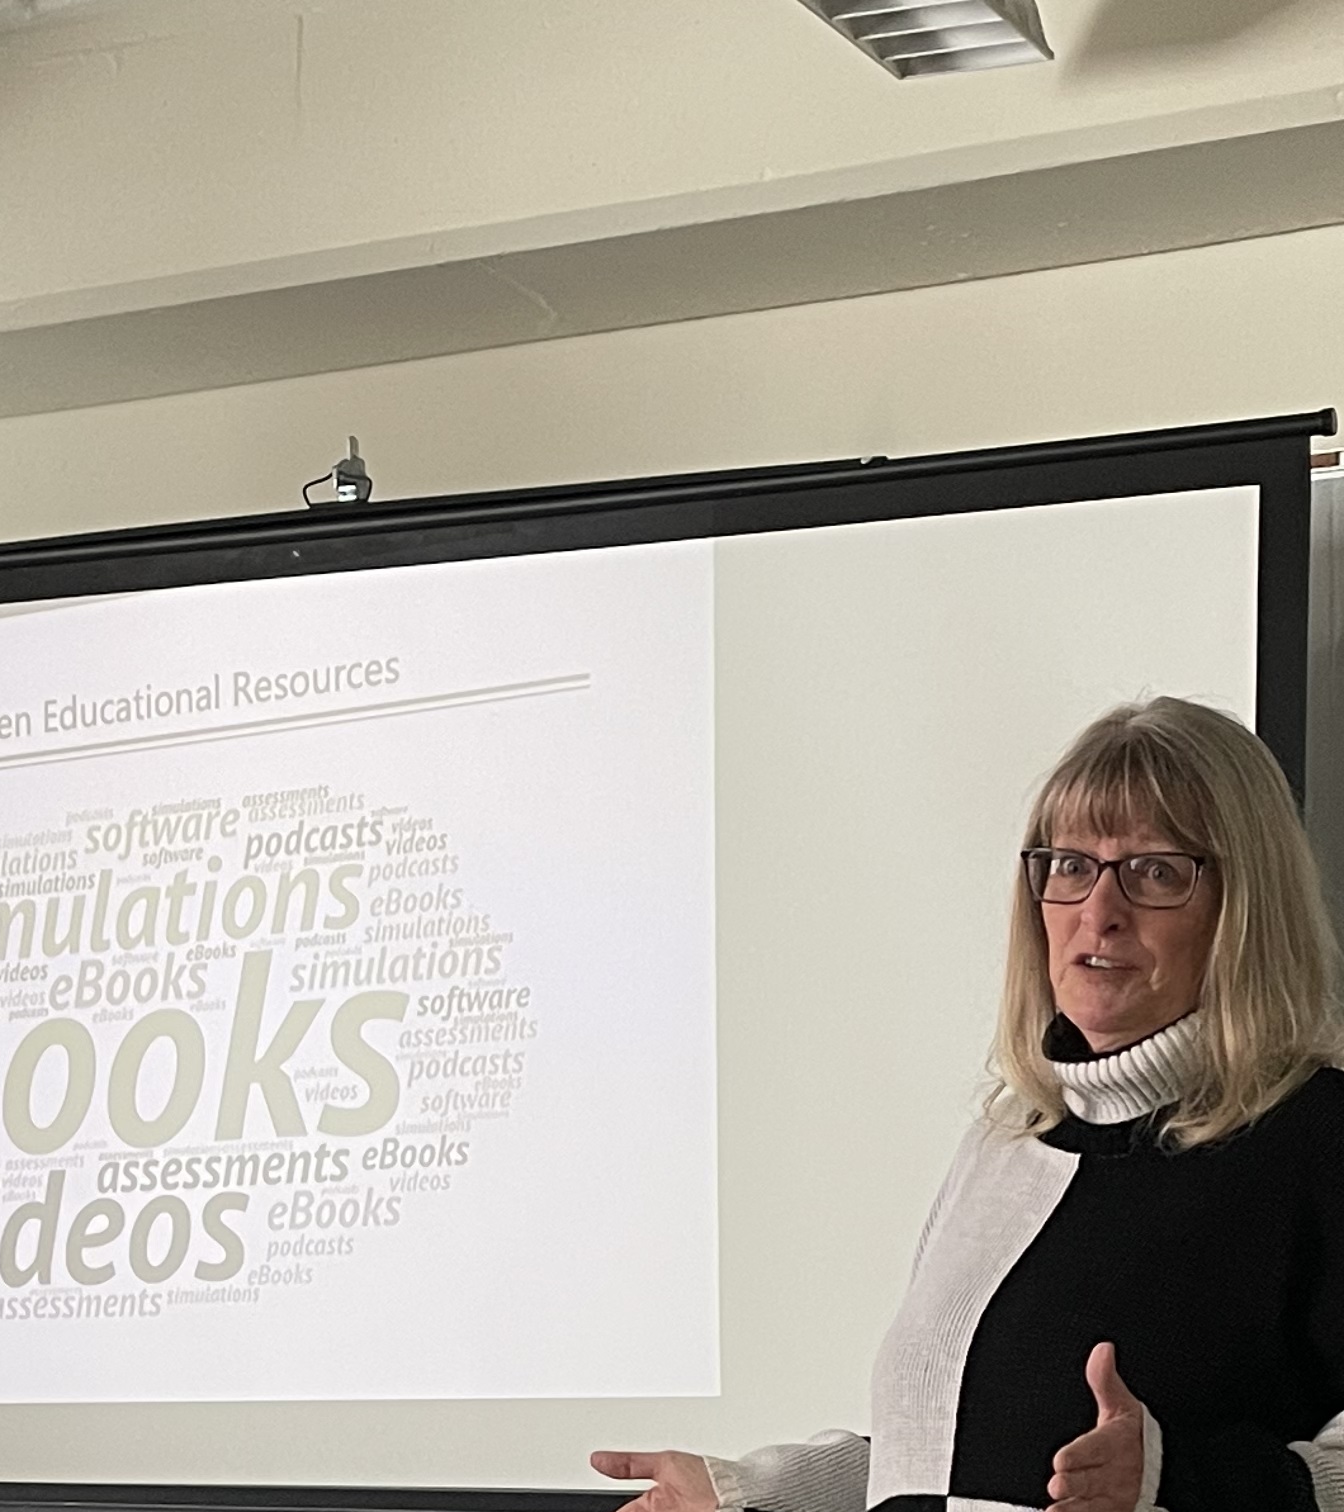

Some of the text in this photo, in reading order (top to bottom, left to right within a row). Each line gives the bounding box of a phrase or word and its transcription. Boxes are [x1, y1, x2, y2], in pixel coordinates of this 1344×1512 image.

[44, 674, 220, 734] Educational
[233, 657, 401, 708] Resources
[241, 784, 329, 808] assessments
[248, 792, 365, 823] assessments
[85, 808, 240, 860] software
[244, 816, 383, 870] podcasts
[385, 832, 448, 856] videos
[142, 847, 204, 869] software
[368, 854, 459, 887] podcasts
[370, 883, 463, 917] eBooks
[295, 933, 346, 951] podcasts
[363, 911, 491, 944] simulations
[186, 943, 236, 961] eBooks
[289, 941, 503, 993] simulations
[50, 952, 207, 1010] eBooks
[417, 986, 531, 1021] software
[399, 1017, 538, 1048] assessments
[408, 1050, 525, 1088] podcasts
[305, 1081, 358, 1102] videos
[420, 1088, 511, 1117] software
[362, 1134, 470, 1170] eBooks
[2, 1174, 44, 1189] videos
[97, 1143, 350, 1194] assessments
[389, 1171, 451, 1193] videos
[267, 1187, 401, 1231] eBooks
[266, 1234, 354, 1262] podcasts
[248, 1263, 313, 1286] eBooks
[167, 1285, 260, 1305] simulations
